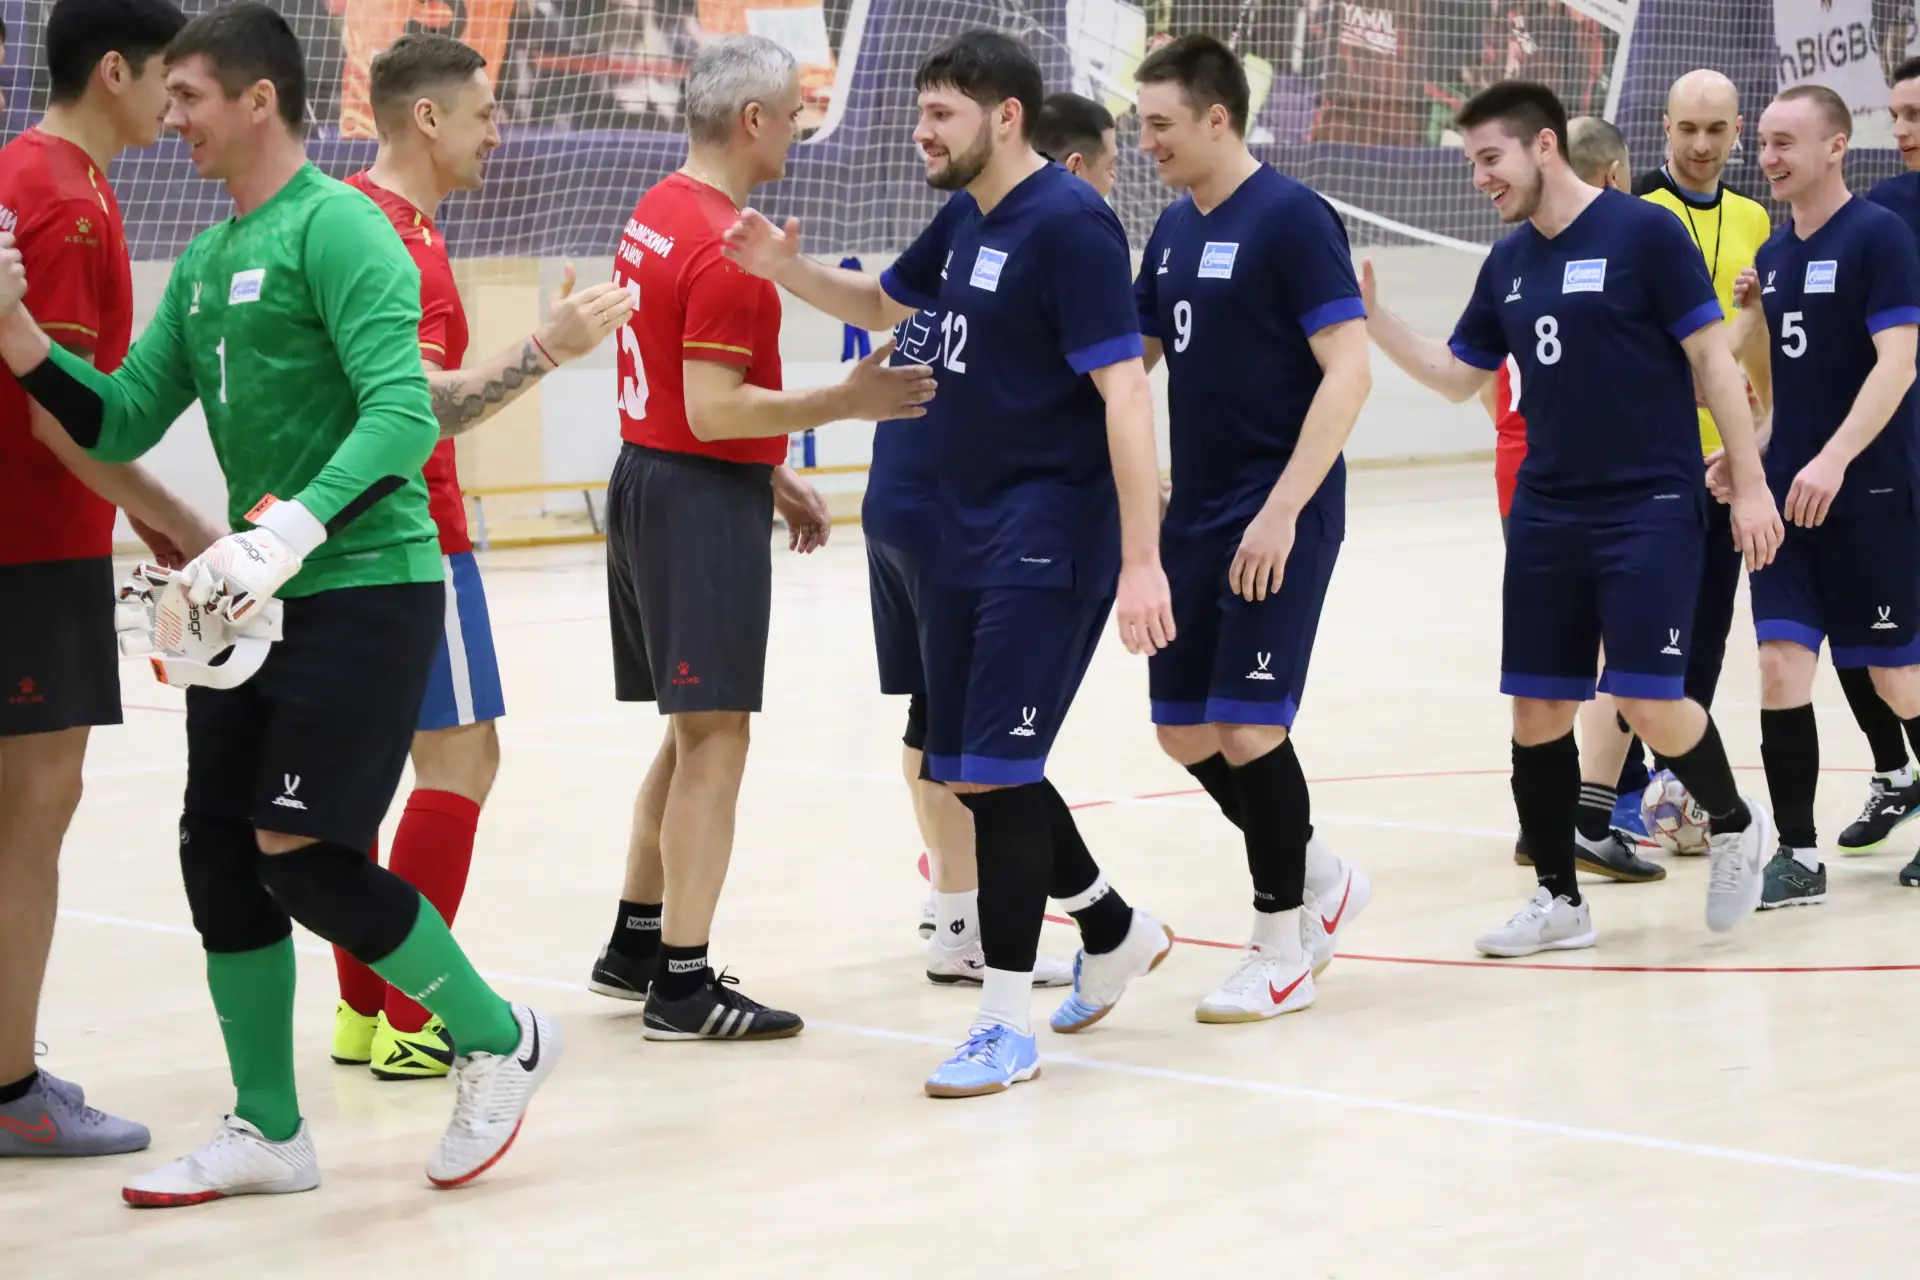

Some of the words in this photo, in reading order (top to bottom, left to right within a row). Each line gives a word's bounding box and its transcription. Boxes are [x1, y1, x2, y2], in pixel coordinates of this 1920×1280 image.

[617, 239, 644, 268] РАЙОН
[941, 310, 968, 374] 12
[1173, 300, 1192, 353] 9
[1535, 315, 1562, 365] 8
[1781, 311, 1808, 358] 5
[215, 336, 228, 404] 1
